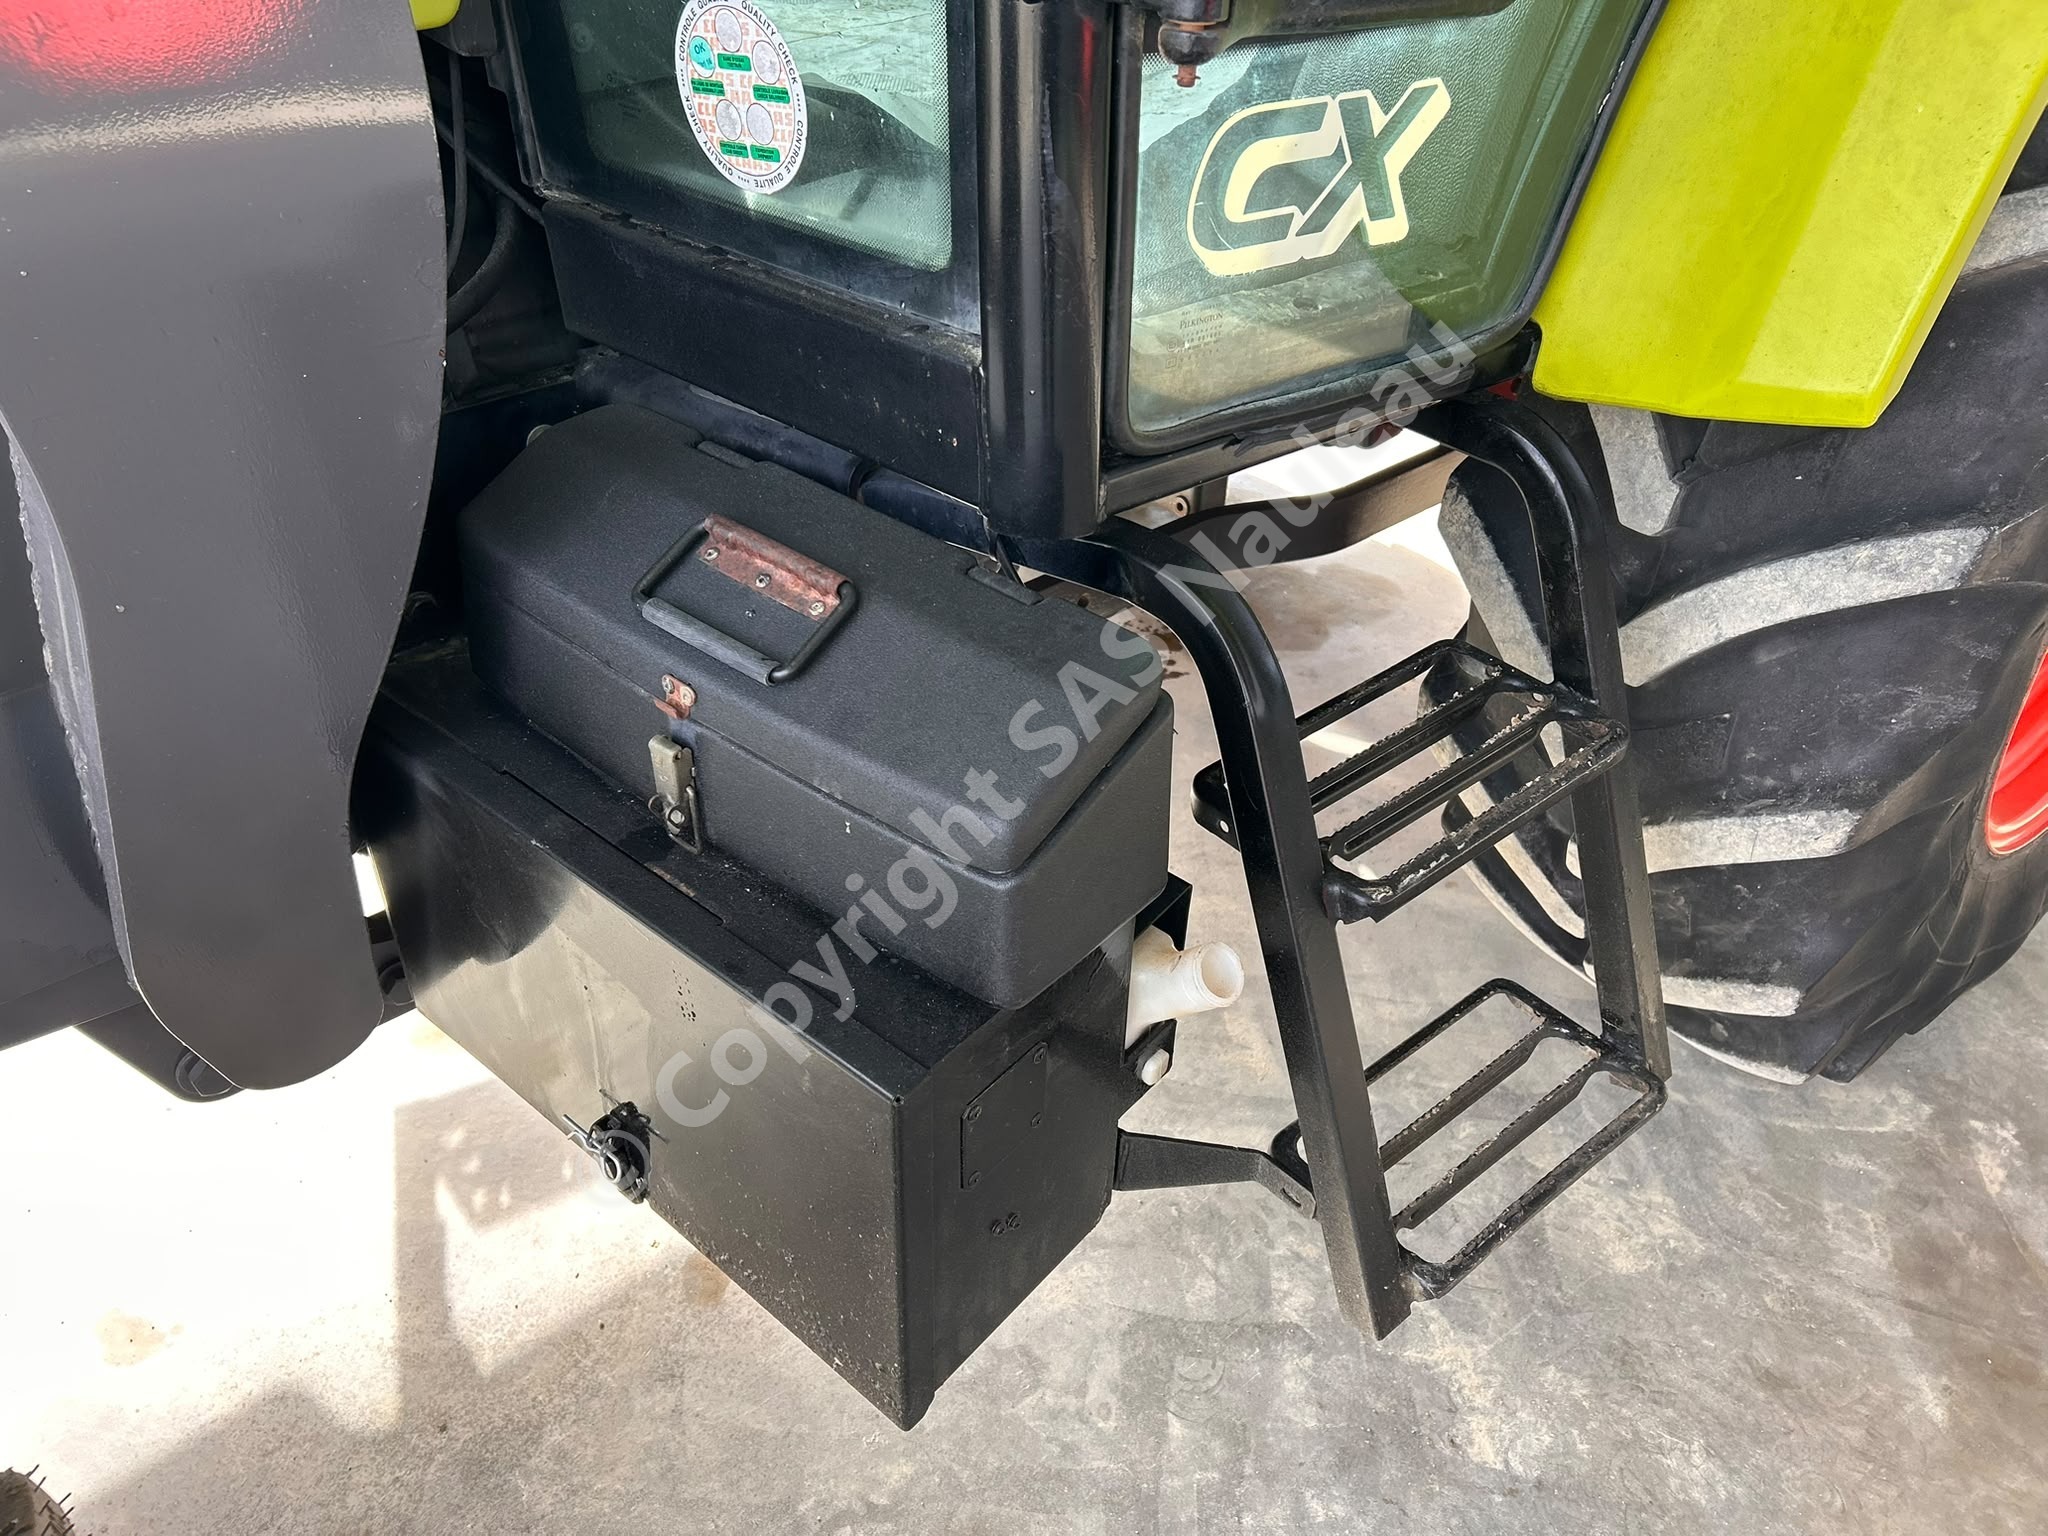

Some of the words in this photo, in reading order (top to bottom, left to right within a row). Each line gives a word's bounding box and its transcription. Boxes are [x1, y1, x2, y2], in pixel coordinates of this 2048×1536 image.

[679, 8, 697, 60] CONTROLE
[693, 42, 706, 55] OK
[741, 0, 776, 36] QUALITY
[778, 42, 799, 85] CHECK
[684, 95, 702, 134] CHECK
[702, 141, 733, 176] QUALITY
[784, 120, 804, 173] CONTROLE
[754, 172, 784, 188] QUALITE
[1186, 77, 1452, 277] CX
[1179, 312, 1223, 330] PILKINGTON
